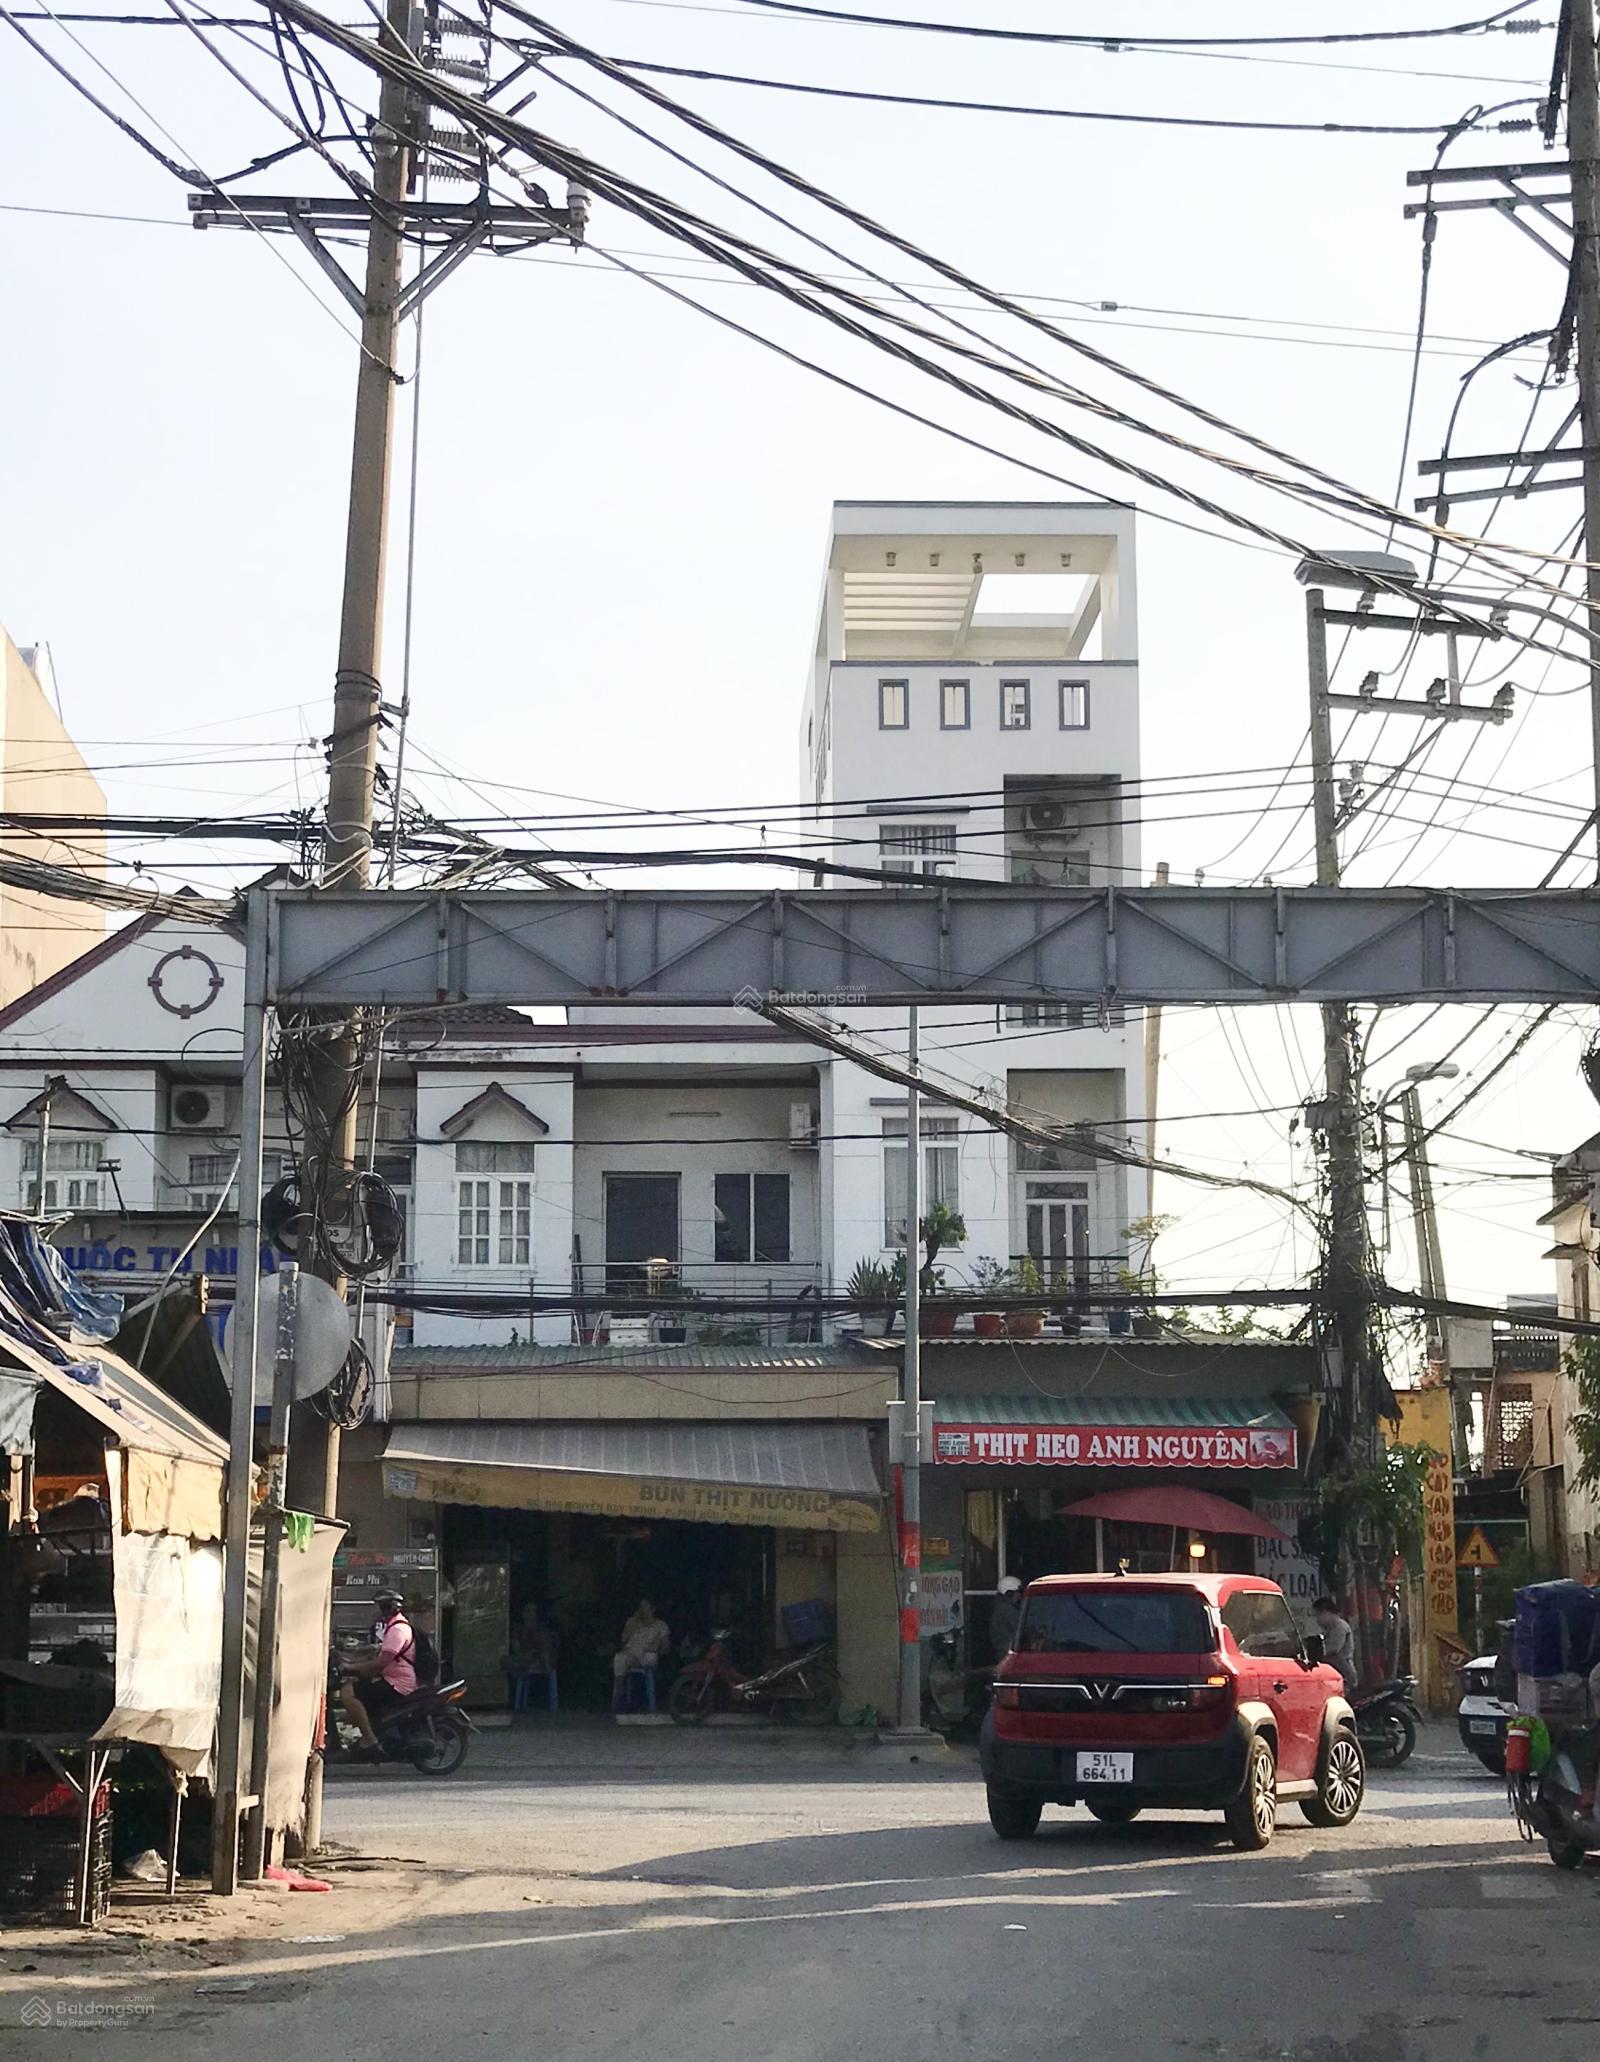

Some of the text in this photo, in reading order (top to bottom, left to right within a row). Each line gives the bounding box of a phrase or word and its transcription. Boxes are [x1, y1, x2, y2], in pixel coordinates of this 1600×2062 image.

[973, 1430, 1248, 1463] THỊT HEO ANH NGUYÊN
[1093, 1754, 1116, 1767] 51L
[1083, 1767, 1125, 1781] 664.11
